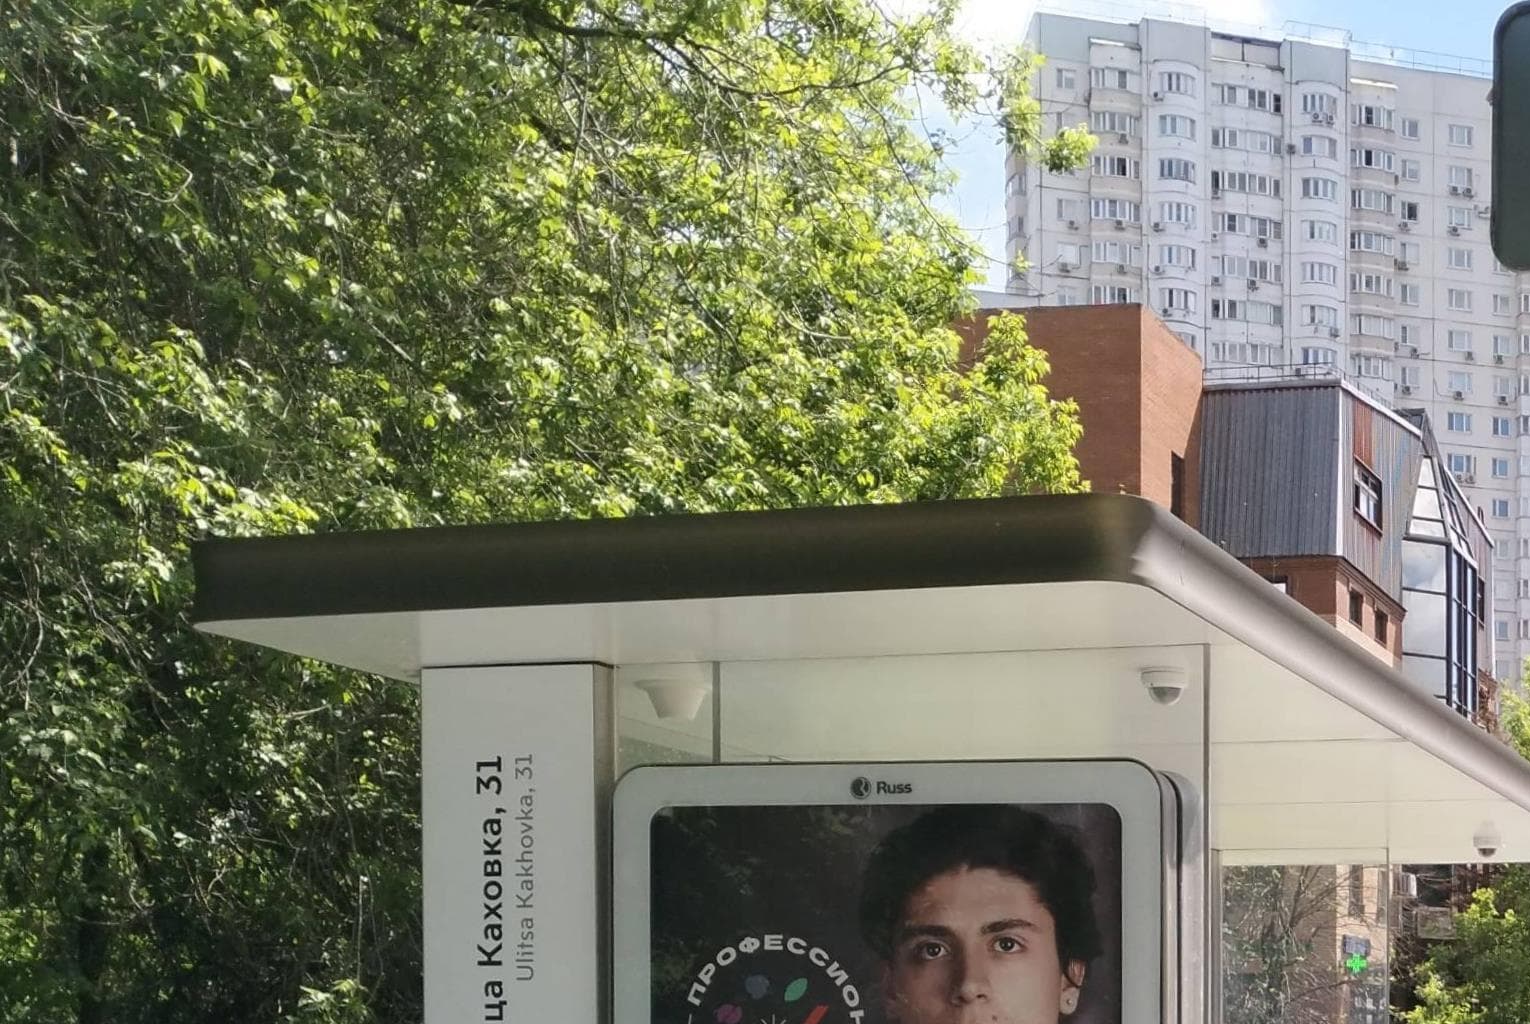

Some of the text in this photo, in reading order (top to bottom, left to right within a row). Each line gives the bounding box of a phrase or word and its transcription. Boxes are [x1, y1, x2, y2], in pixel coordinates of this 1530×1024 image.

[476, 755, 503, 796] 31
[876, 780, 913, 795] Russ
[476, 807, 507, 967] Каховка,
[514, 753, 536, 982] Ulitsa Kakhovka, 31
